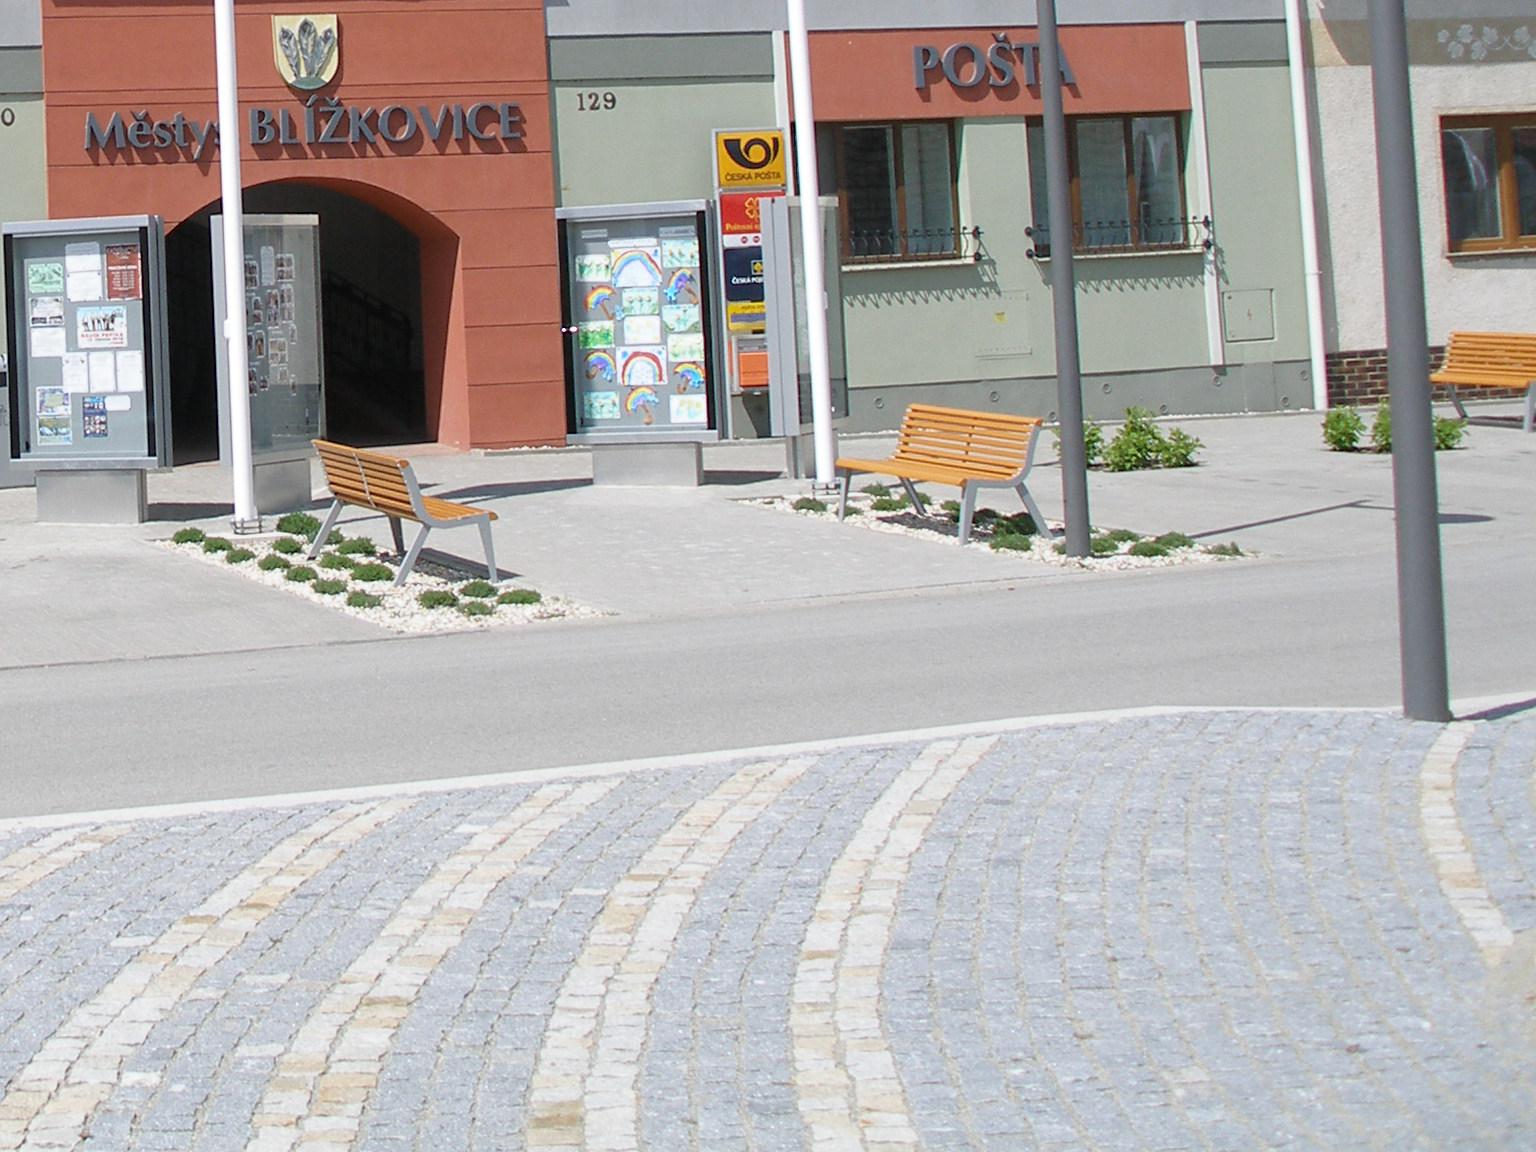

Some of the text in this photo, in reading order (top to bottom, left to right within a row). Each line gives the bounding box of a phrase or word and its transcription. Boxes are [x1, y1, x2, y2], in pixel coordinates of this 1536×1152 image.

[576, 91, 617, 112] 129
[248, 94, 522, 146] BLÍŽKOVICE
[724, 170, 782, 182] ČESKÁ POŠTA
